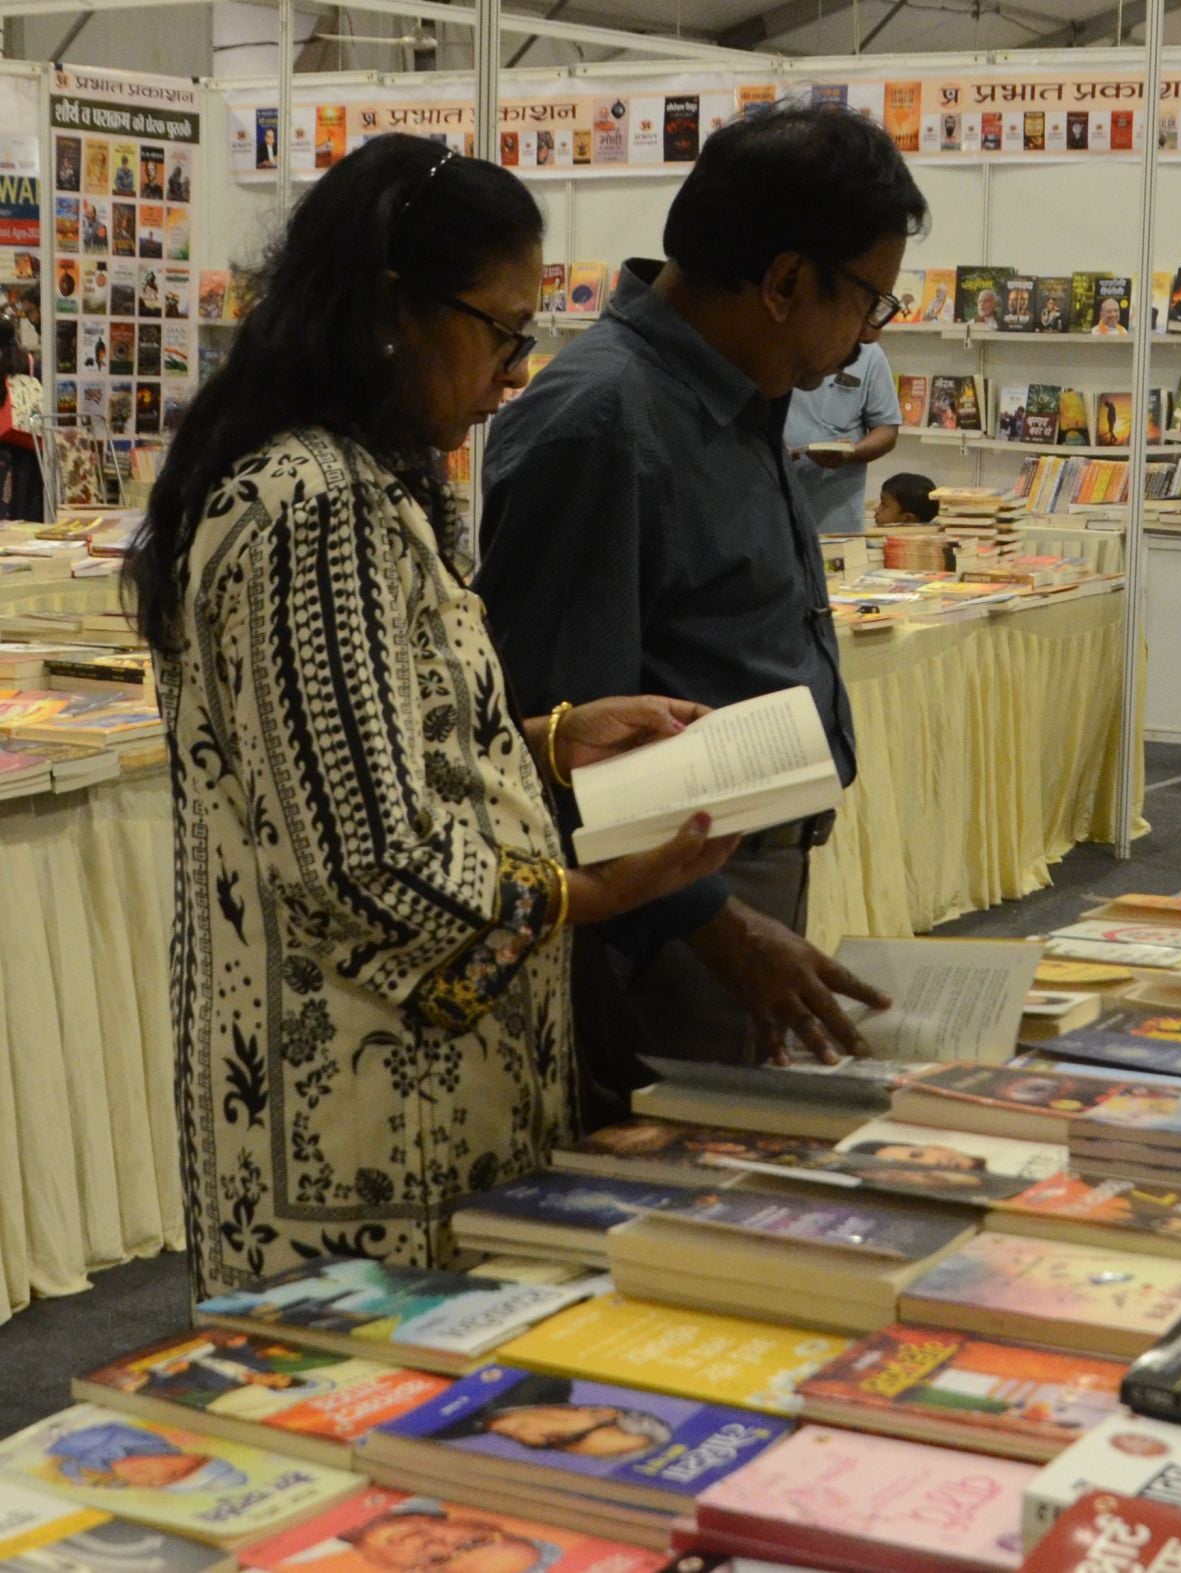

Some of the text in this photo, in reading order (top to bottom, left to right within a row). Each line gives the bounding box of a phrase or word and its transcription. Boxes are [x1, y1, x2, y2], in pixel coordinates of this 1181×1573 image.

[75, 76, 124, 94] प्रभात
[127, 83, 195, 104] प्रकाशन
[971, 82, 1067, 103] प्रभात
[385, 107, 463, 126] प्रभात
[469, 103, 578, 122] काशन
[0, 176, 41, 206] WA
